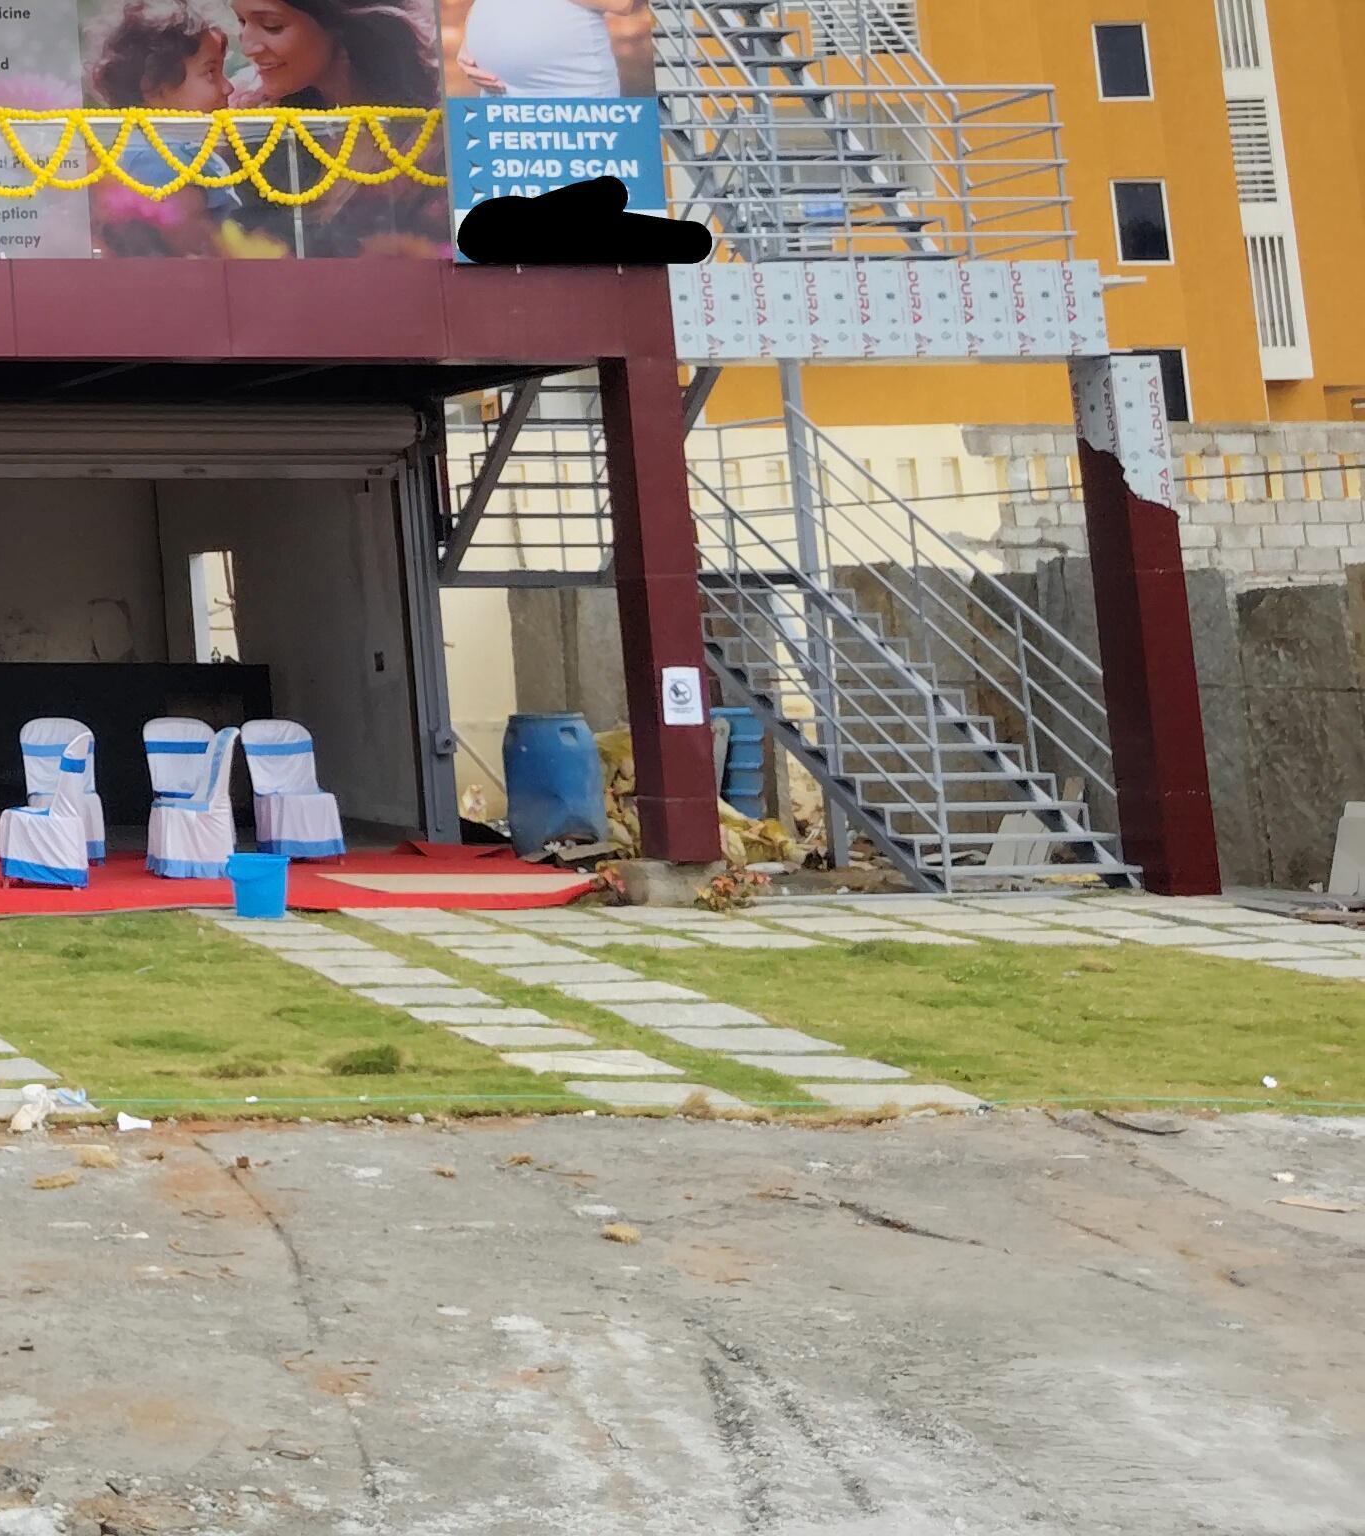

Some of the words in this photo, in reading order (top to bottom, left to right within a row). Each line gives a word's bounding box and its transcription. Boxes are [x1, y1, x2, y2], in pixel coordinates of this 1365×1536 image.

[487, 105, 643, 124] PREGNANCY
[488, 132, 618, 150] FERTILITY
[492, 159, 562, 179] 3D/4D
[570, 159, 639, 178] SCAN
